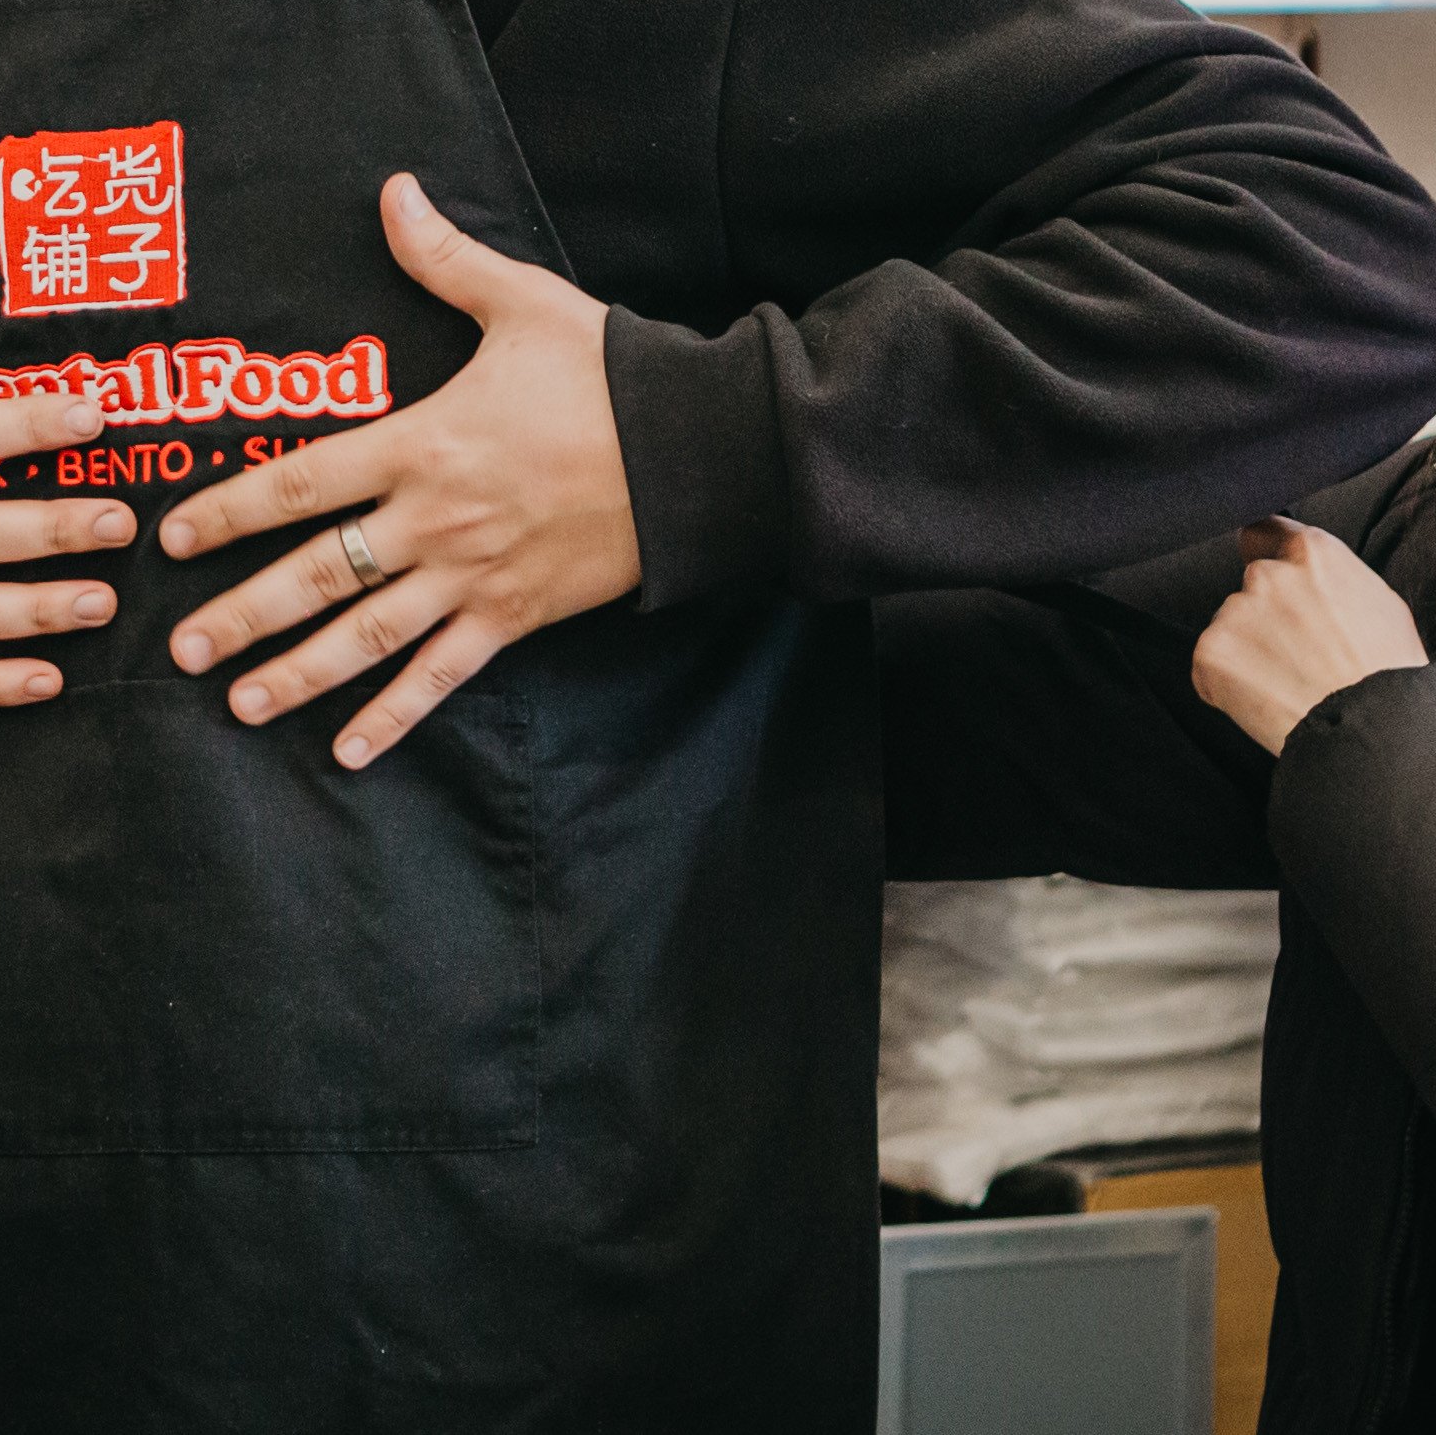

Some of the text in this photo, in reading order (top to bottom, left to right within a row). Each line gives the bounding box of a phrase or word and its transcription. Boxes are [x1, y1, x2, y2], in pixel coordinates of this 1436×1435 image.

[11, 142, 177, 219] 吃货
[21, 223, 171, 299] 铺子
[175, 342, 380, 412] Food
[57, 440, 194, 487] BENTO
